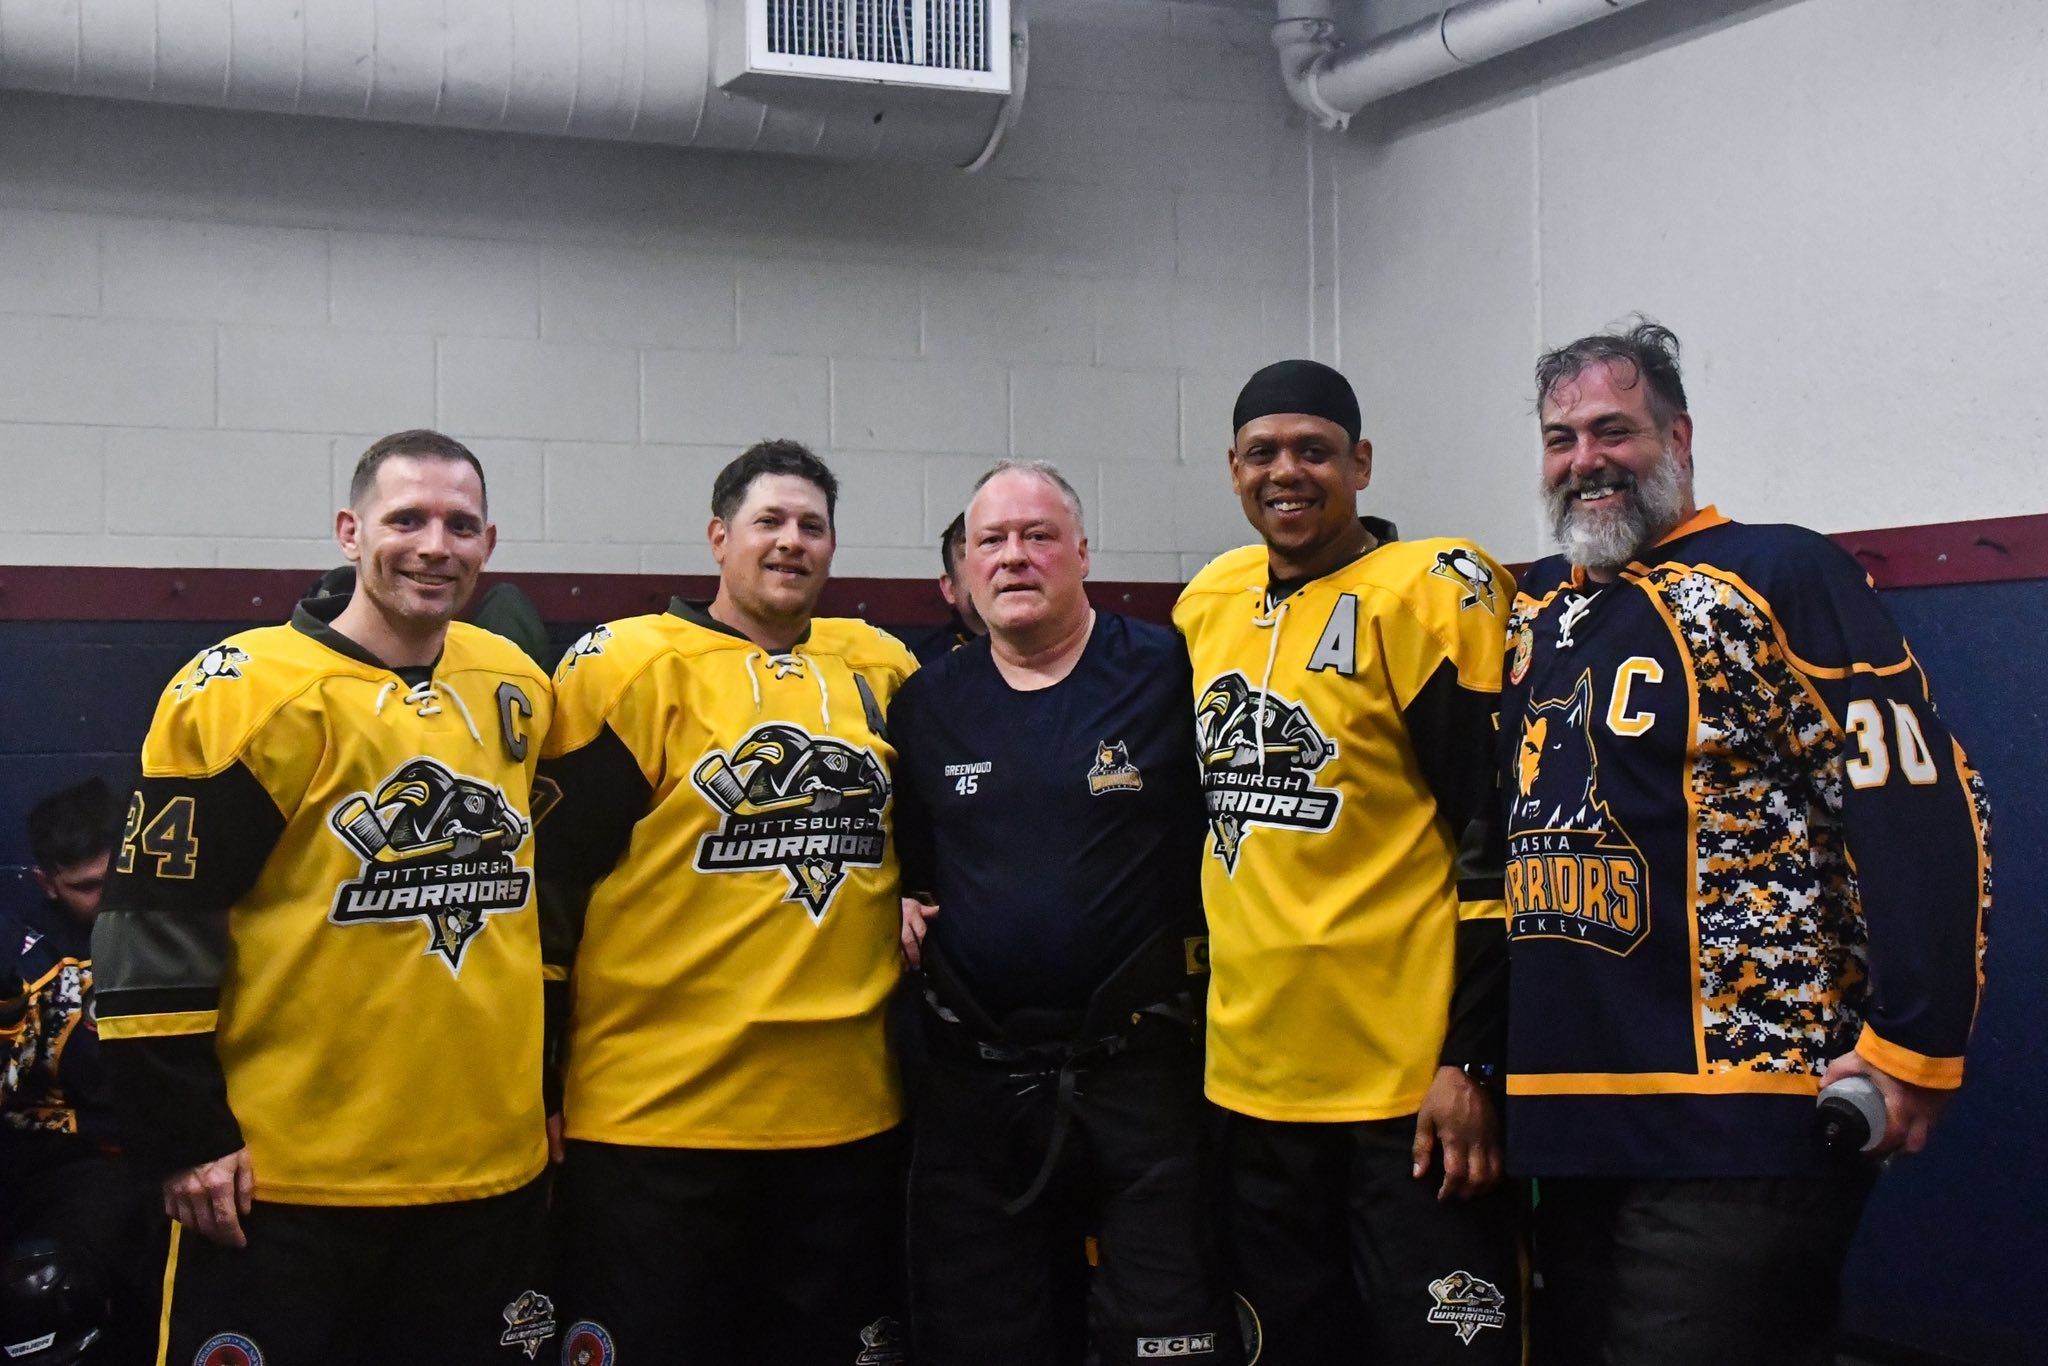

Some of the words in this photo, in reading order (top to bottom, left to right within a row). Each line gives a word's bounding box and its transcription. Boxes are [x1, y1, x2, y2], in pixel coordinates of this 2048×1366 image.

[1306, 592, 1358, 675] A
[1606, 655, 1664, 738] C
[495, 681, 533, 763] C
[1845, 698, 1938, 790] 30
[944, 761, 992, 777] GREENWOOD
[955, 774, 979, 796] 45
[1205, 790, 1329, 821] RRIORS
[116, 790, 198, 880] 24
[374, 861, 509, 884] PITTSBURGH
[347, 878, 525, 912] WARRIORS
[1433, 1311, 1503, 1323] WARRIORS
[1142, 1335, 1212, 1354] CCM
